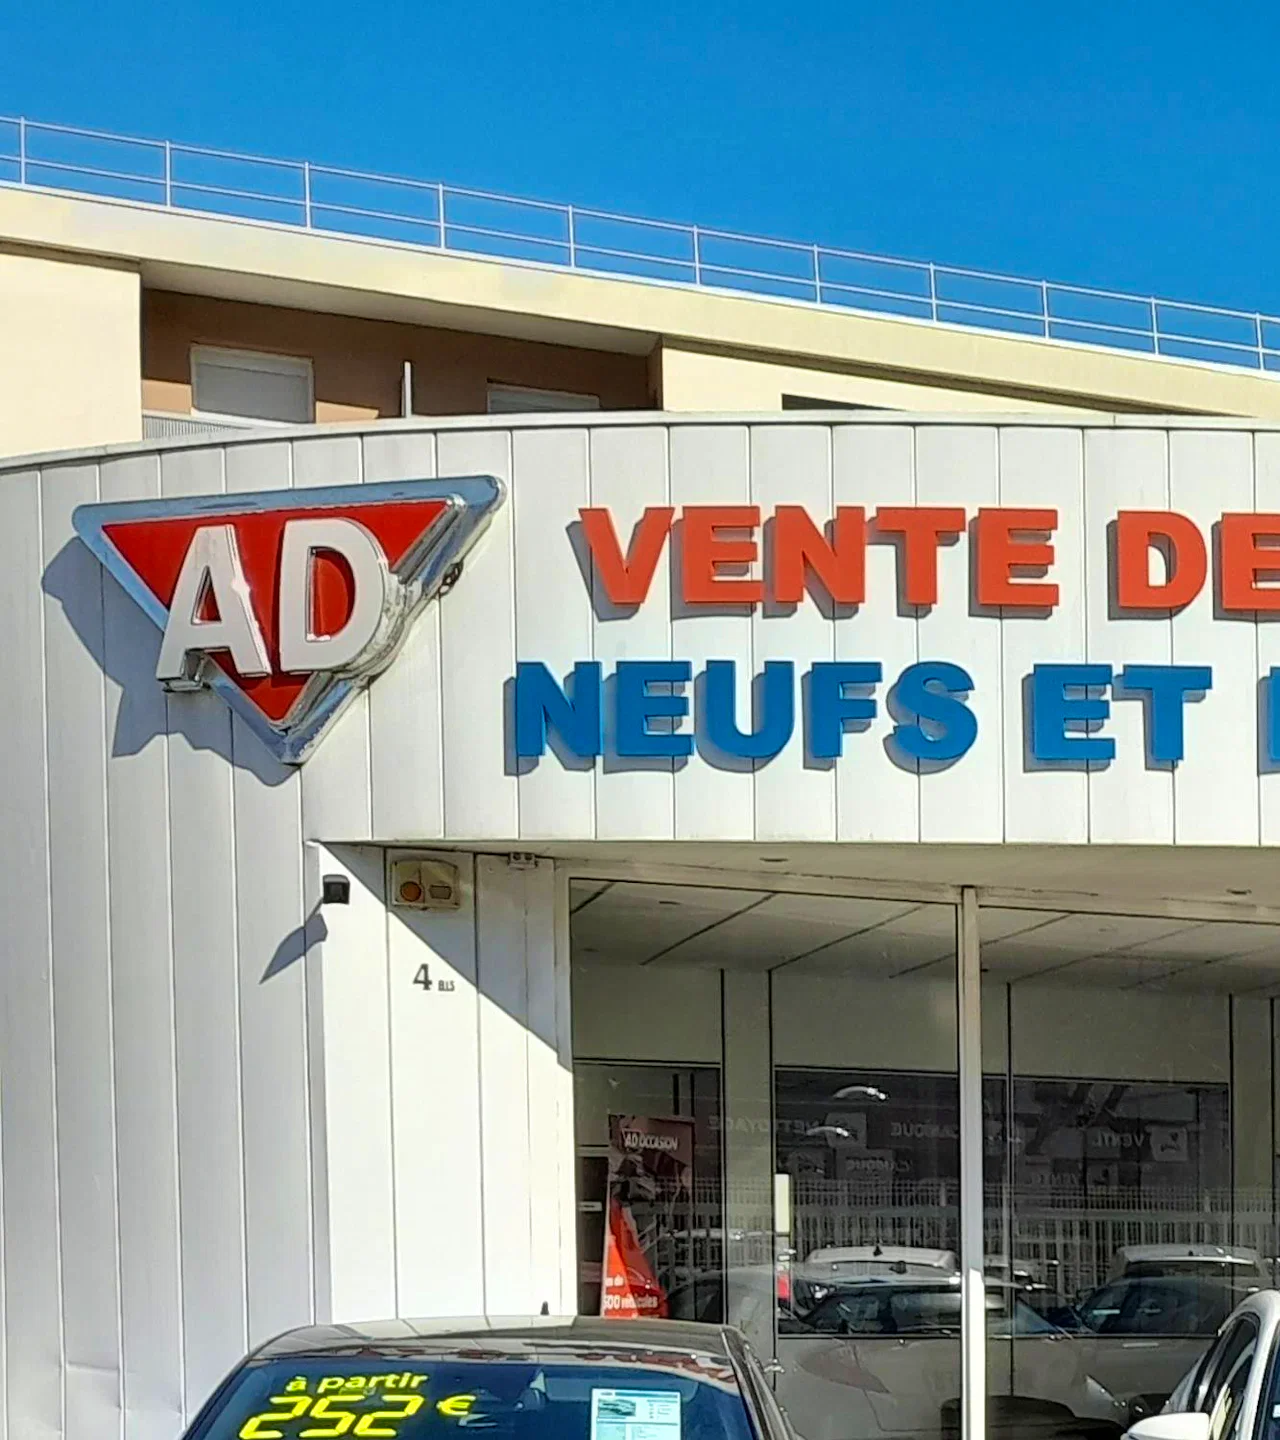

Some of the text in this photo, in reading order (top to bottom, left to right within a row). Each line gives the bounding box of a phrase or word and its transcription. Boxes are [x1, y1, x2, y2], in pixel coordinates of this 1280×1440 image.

[578, 506, 1060, 609] VENTE
[157, 517, 392, 682] AD
[514, 660, 979, 763] NEUFS
[1032, 664, 1213, 762] ET
[413, 963, 433, 991] 4
[640, 1133, 679, 1151] OCCASION
[285, 1372, 429, 1394] à partir
[239, 1394, 476, 1440] 252 €
